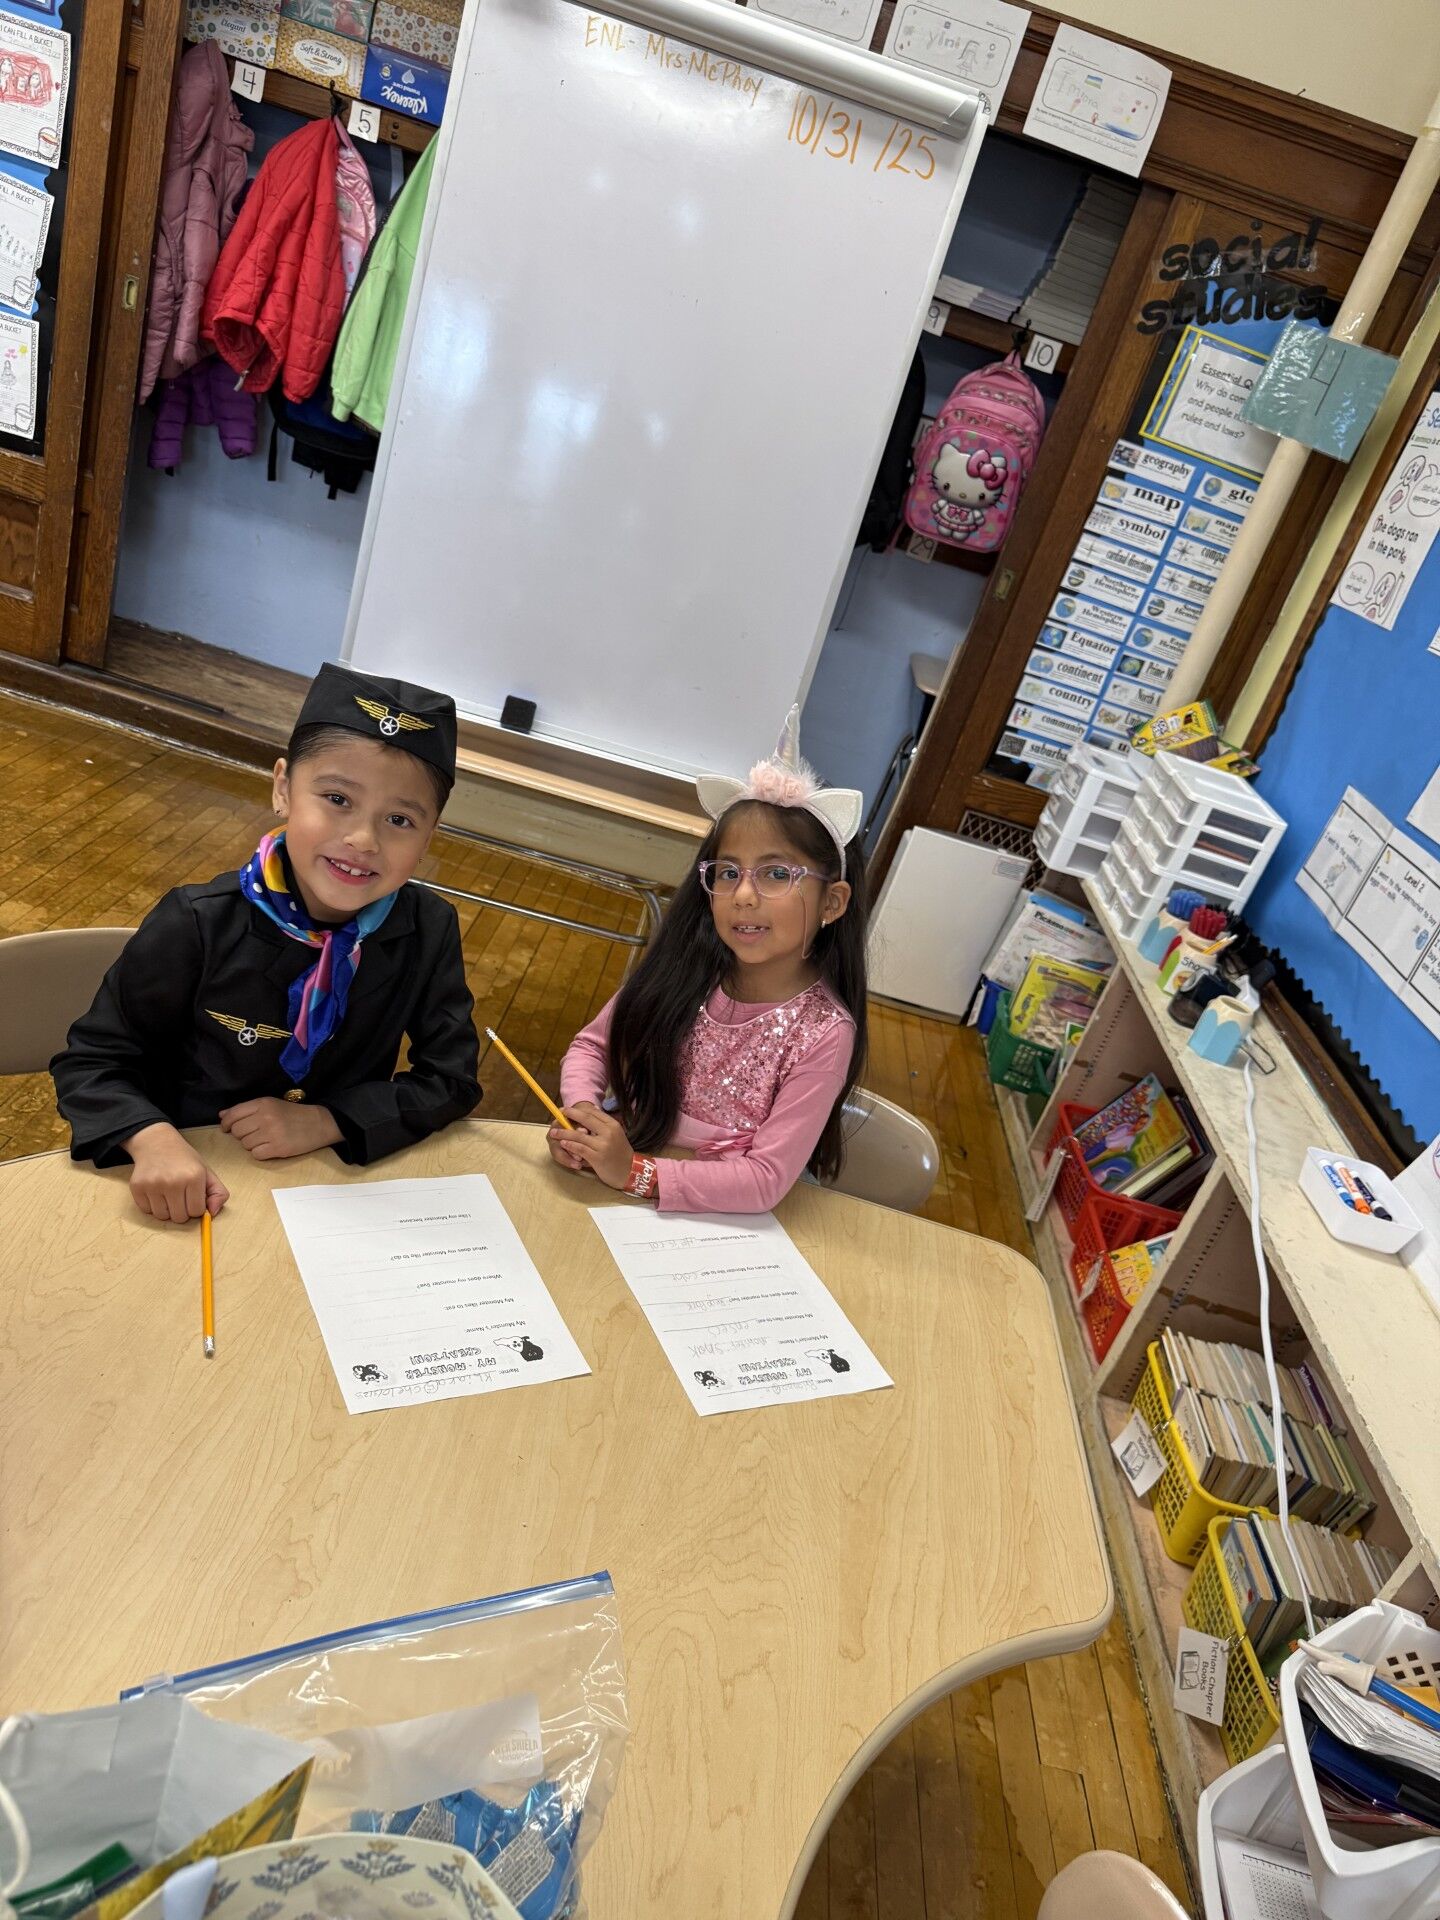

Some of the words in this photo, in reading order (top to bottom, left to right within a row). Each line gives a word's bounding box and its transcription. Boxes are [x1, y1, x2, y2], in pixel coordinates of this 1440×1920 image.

[34, 35, 53, 48] BUCKET
[300, 42, 315, 56] Soft
[319, 50, 342, 67] Strong
[242, 67, 257, 95] 4
[380, 85, 428, 115] Kleenex
[358, 109, 372, 134] 5
[15, 192, 35, 205] BUCKET
[1159, 215, 1323, 282] social
[1136, 273, 1328, 335] studies
[927, 304, 941, 328] 9
[1031, 343, 1055, 367] 10
[1200, 363, 1242, 386] Essential
[1195, 379, 1214, 395] Why
[1187, 396, 1204, 408] and
[1204, 401, 1232, 419] people
[1204, 420, 1221, 432] and
[1141, 452, 1192, 478] geography
[1132, 486, 1181, 512] map
[1228, 487, 1255, 504] glo
[1117, 517, 1167, 542] symbol
[1214, 518, 1239, 532] map
[1387, 522, 1406, 541] dogs
[1405, 530, 1419, 543] ran
[1375, 539, 1388, 554] the
[1070, 631, 1116, 655] Equator
[1056, 661, 1104, 684] continent
[1048, 682, 1094, 709] country
[1041, 713, 1086, 735] community
[1029, 743, 1068, 762] suburba
[1404, 871, 1420, 888] Level
[410, 1347, 482, 1365] CREATION!
[477, 1357, 497, 1368] MY
[738, 1357, 797, 1373] CREATION!
[405, 1362, 467, 1380] MONSTER
[737, 1371, 789, 1386] MONSTER
[796, 1367, 813, 1377] MY
[1210, 1641, 1219, 1674] Fiction
[1200, 1661, 1209, 1691] Books
[1205, 1676, 1216, 1718] Chapter
